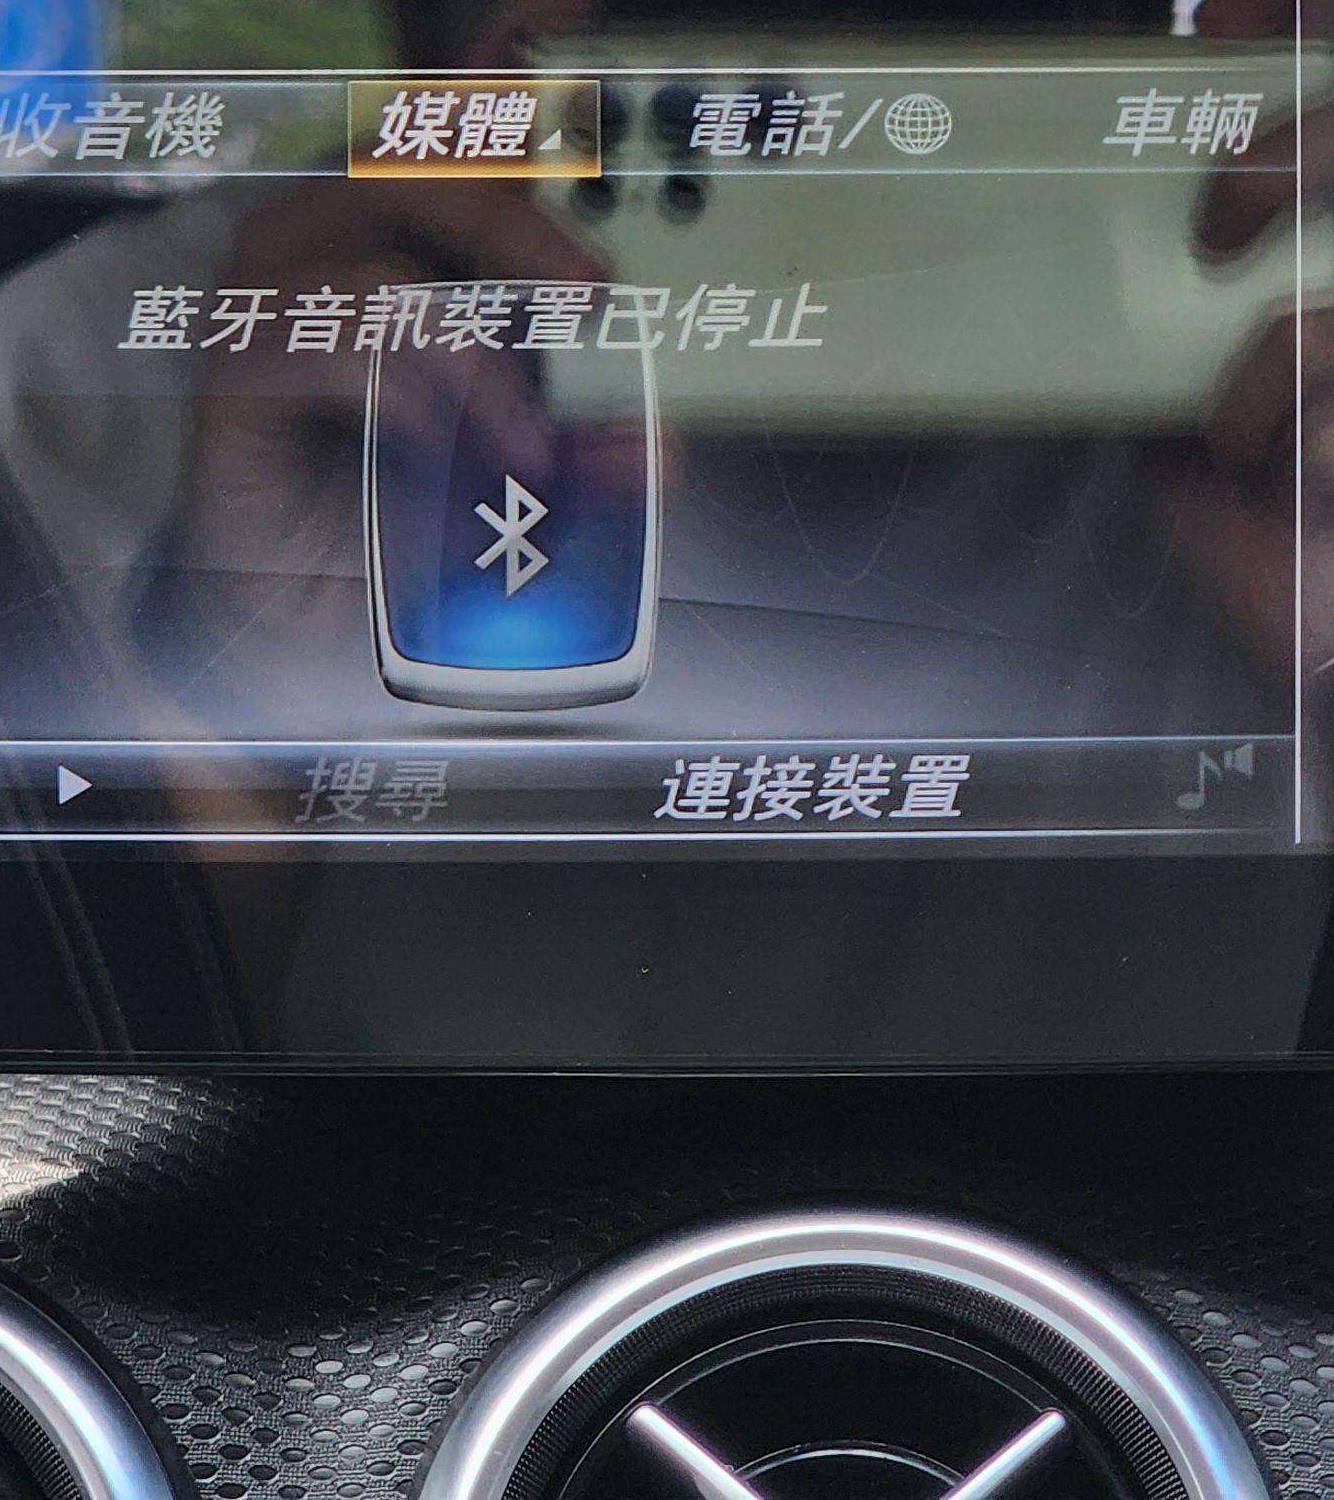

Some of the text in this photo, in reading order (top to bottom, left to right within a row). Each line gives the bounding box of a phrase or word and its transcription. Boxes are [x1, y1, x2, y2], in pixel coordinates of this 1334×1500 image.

[371, 90, 538, 160] 媒體
[1103, 88, 1264, 156] 車輛
[117, 283, 829, 353] 藍牙音訊裝置已停止
[293, 756, 451, 824] 搜尋
[653, 754, 971, 821] 連接裝置
